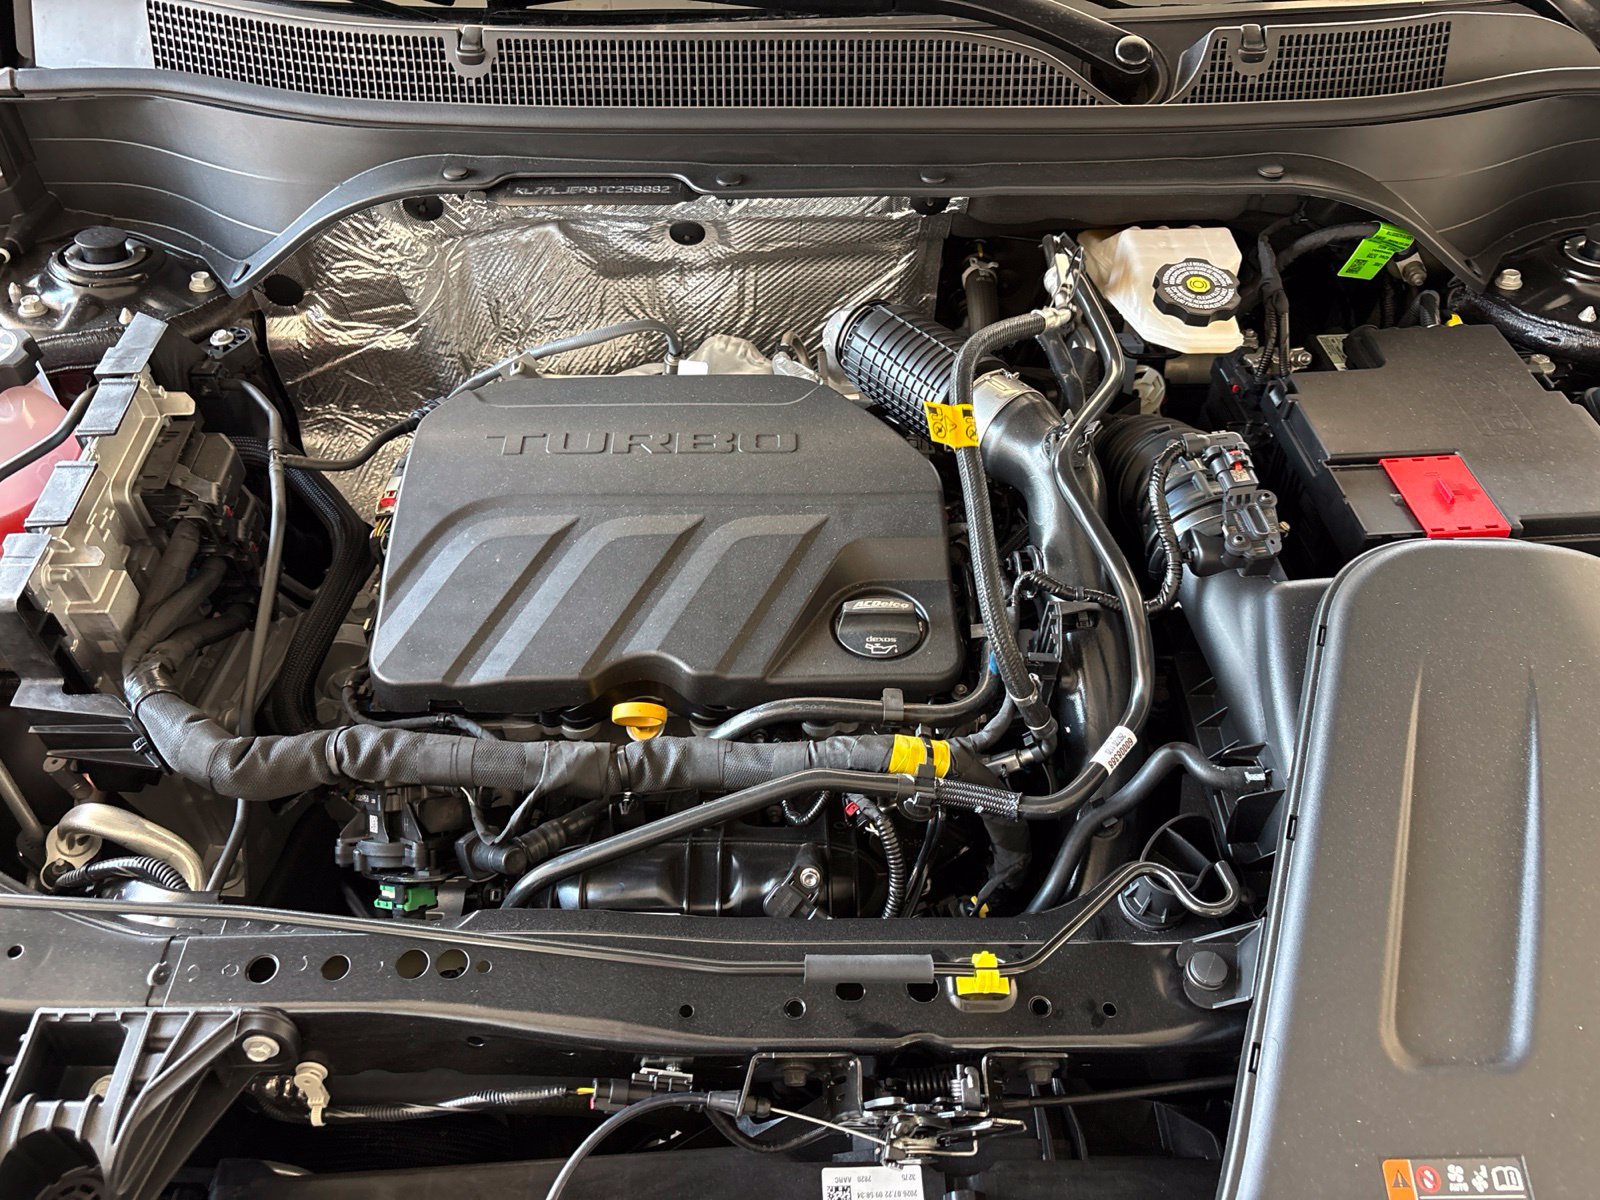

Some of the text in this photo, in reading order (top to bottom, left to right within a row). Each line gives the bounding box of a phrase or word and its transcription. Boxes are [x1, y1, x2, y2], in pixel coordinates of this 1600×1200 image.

[514, 185, 671, 195] KL77LJEP8TC258882
[485, 432, 798, 455] TURBO
[852, 600, 910, 610] ACDelco
